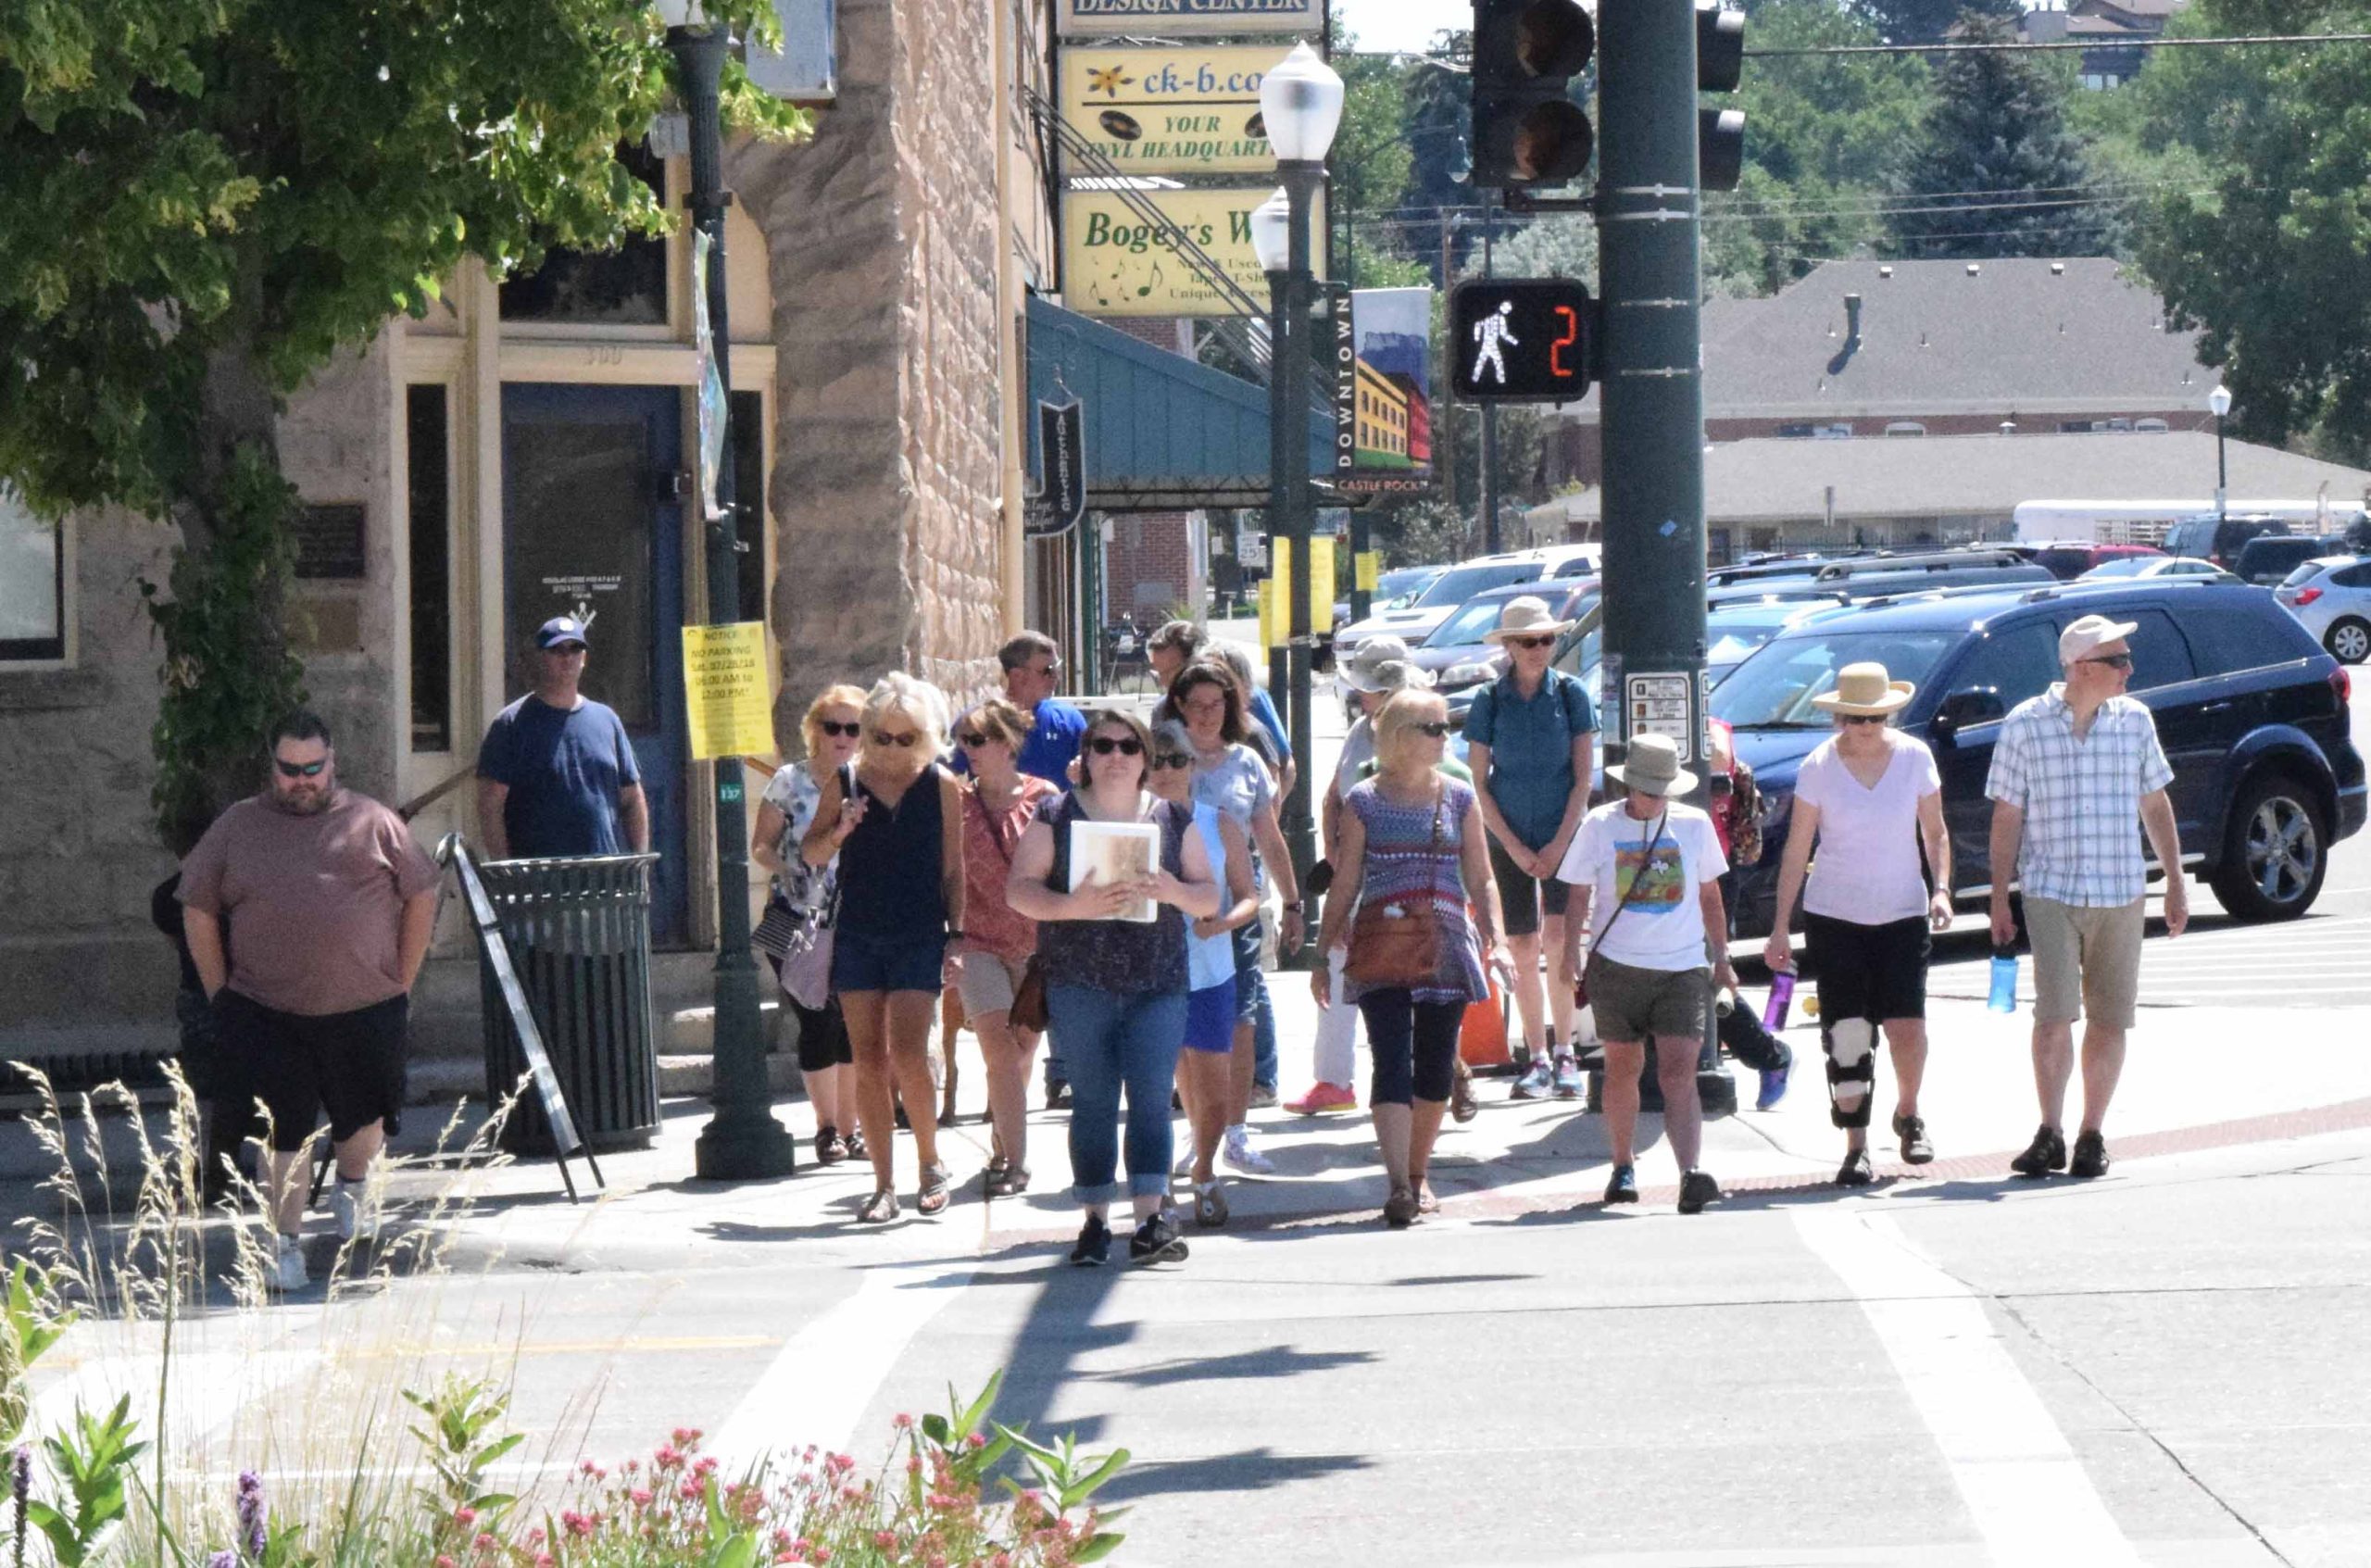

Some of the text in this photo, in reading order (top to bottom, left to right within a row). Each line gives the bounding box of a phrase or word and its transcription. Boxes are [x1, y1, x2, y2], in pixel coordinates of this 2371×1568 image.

[1144, 63, 1261, 94] ck-b.co
[1165, 116, 1222, 133] YOUR
[1140, 140, 1274, 162] HEADQUART
[1549, 306, 1577, 378] 2
[1336, 298, 1352, 468] DOWNTOWN
[1338, 479, 1419, 492] CASTLE ROCK
